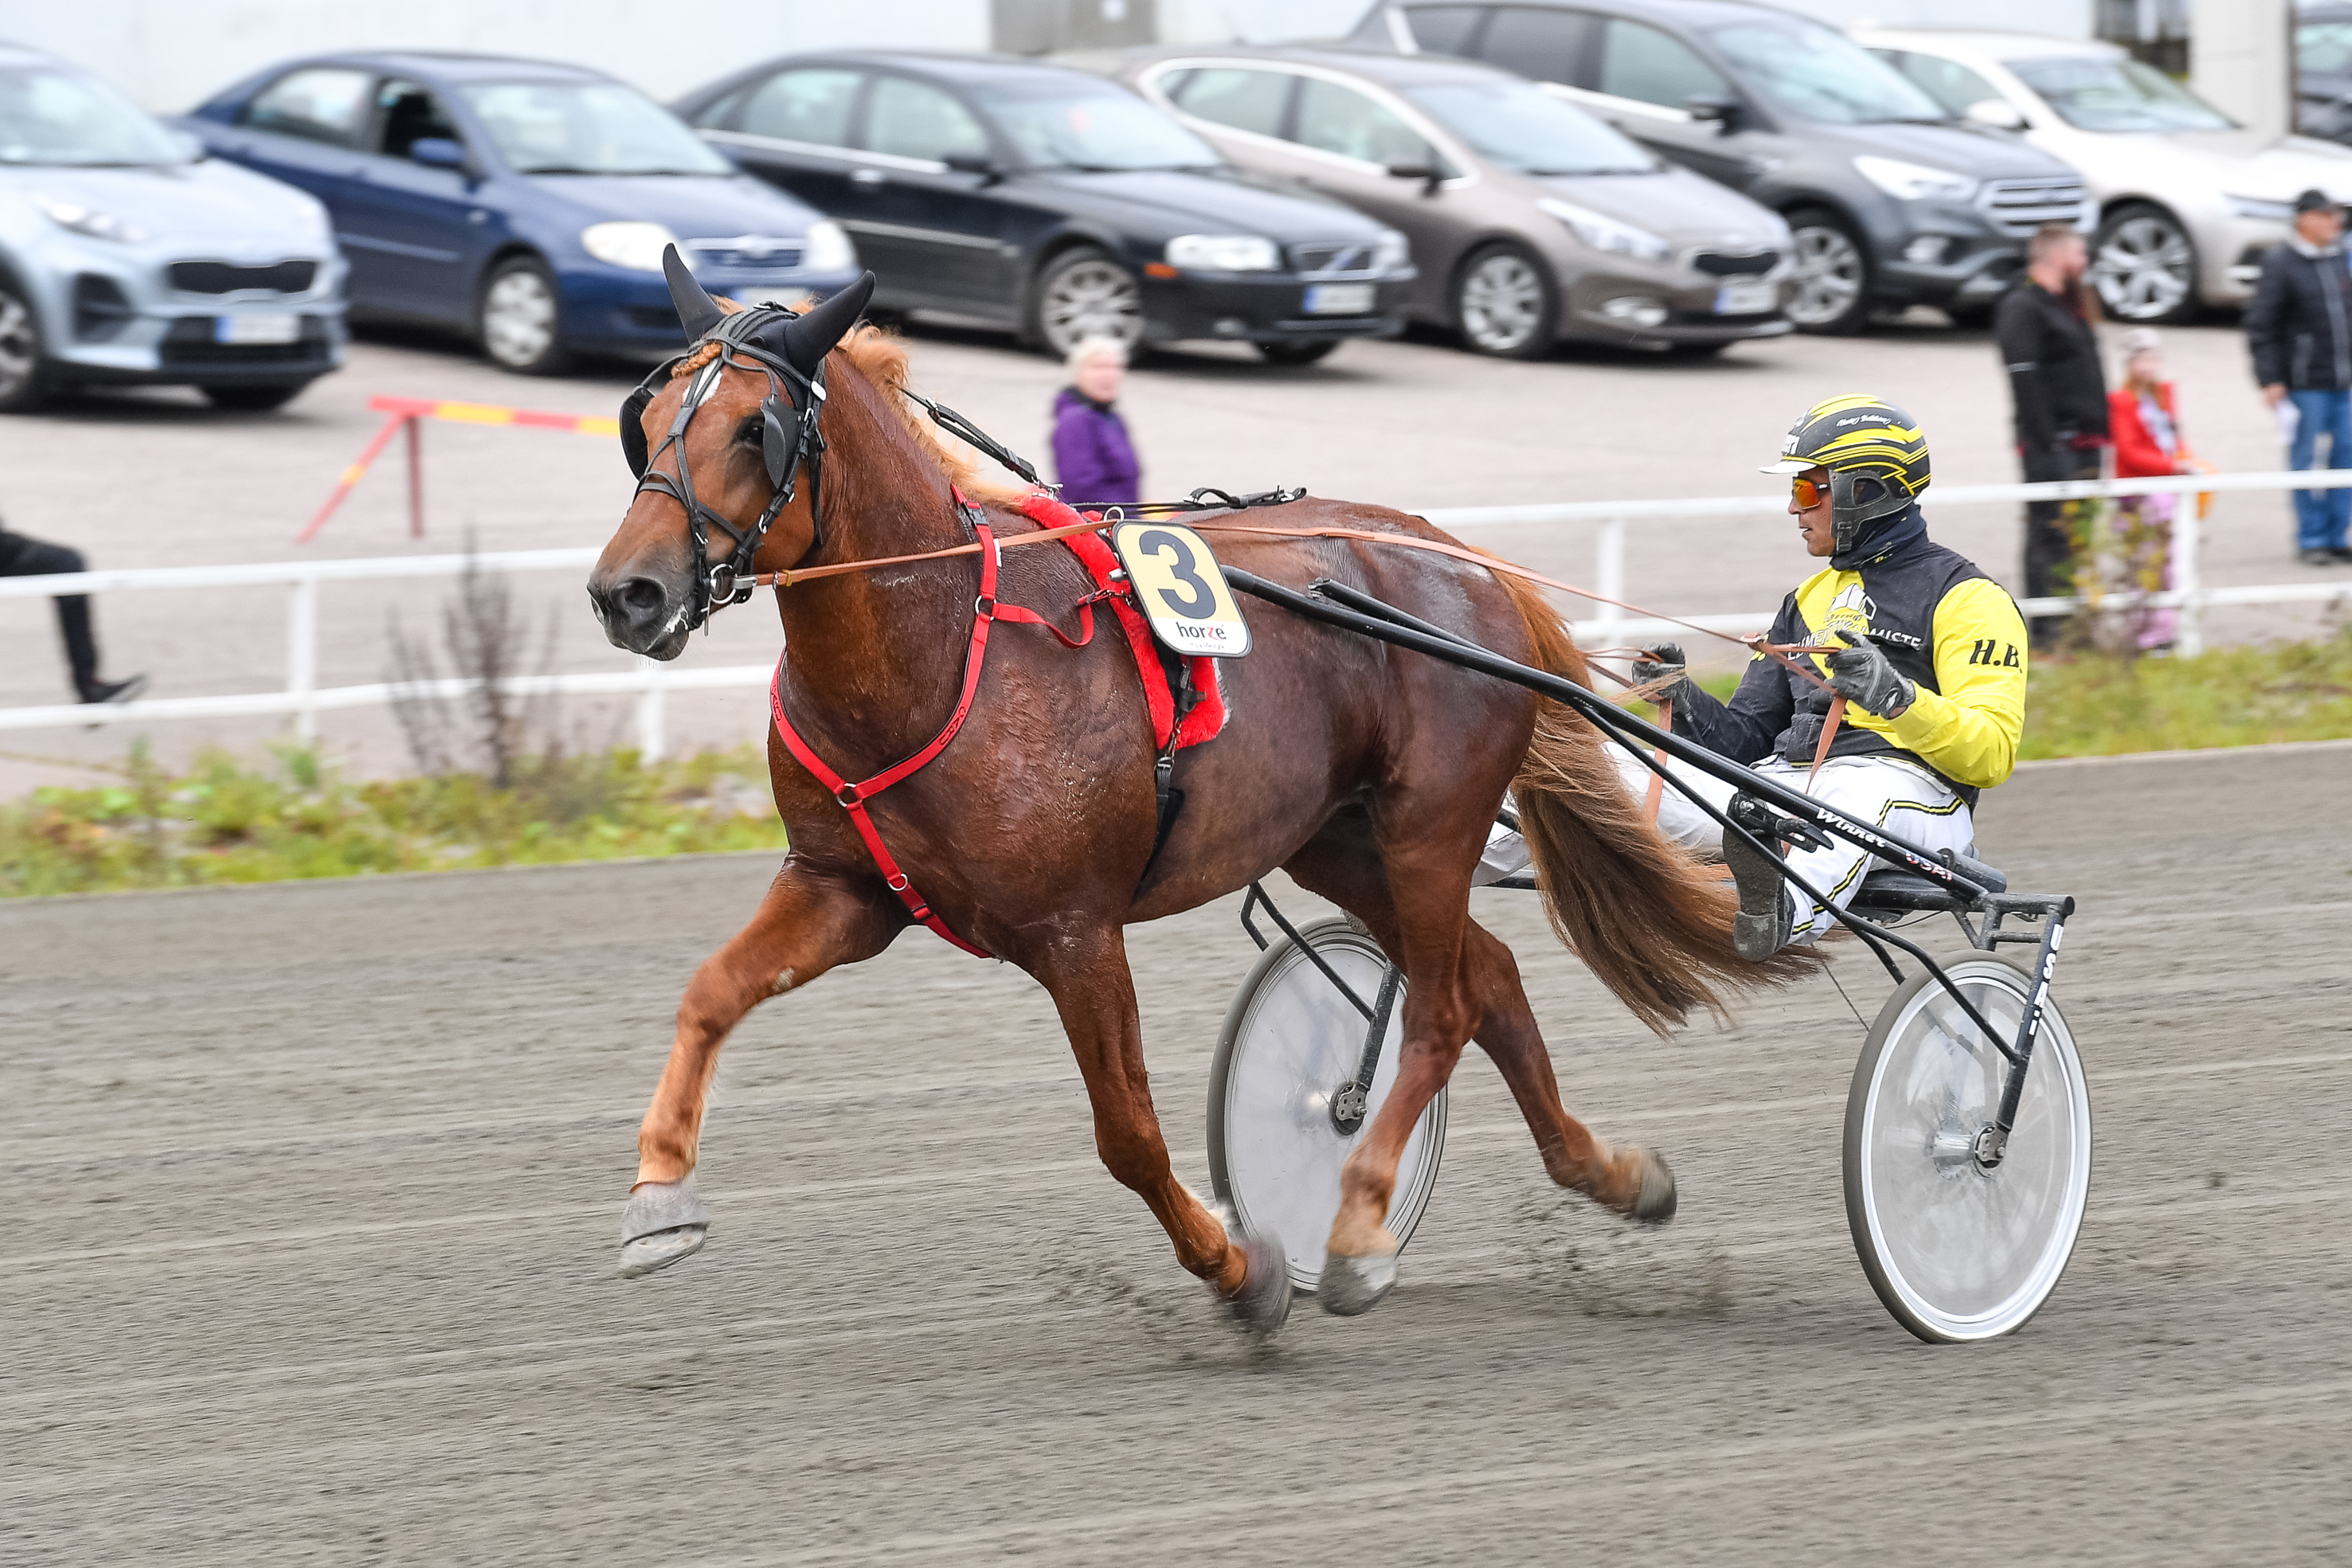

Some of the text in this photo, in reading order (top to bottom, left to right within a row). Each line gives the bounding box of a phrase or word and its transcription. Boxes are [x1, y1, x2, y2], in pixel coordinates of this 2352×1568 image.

[1139, 530, 1216, 620] 3
[1176, 621, 1227, 641] horze
[1816, 807, 1886, 848] Winner
